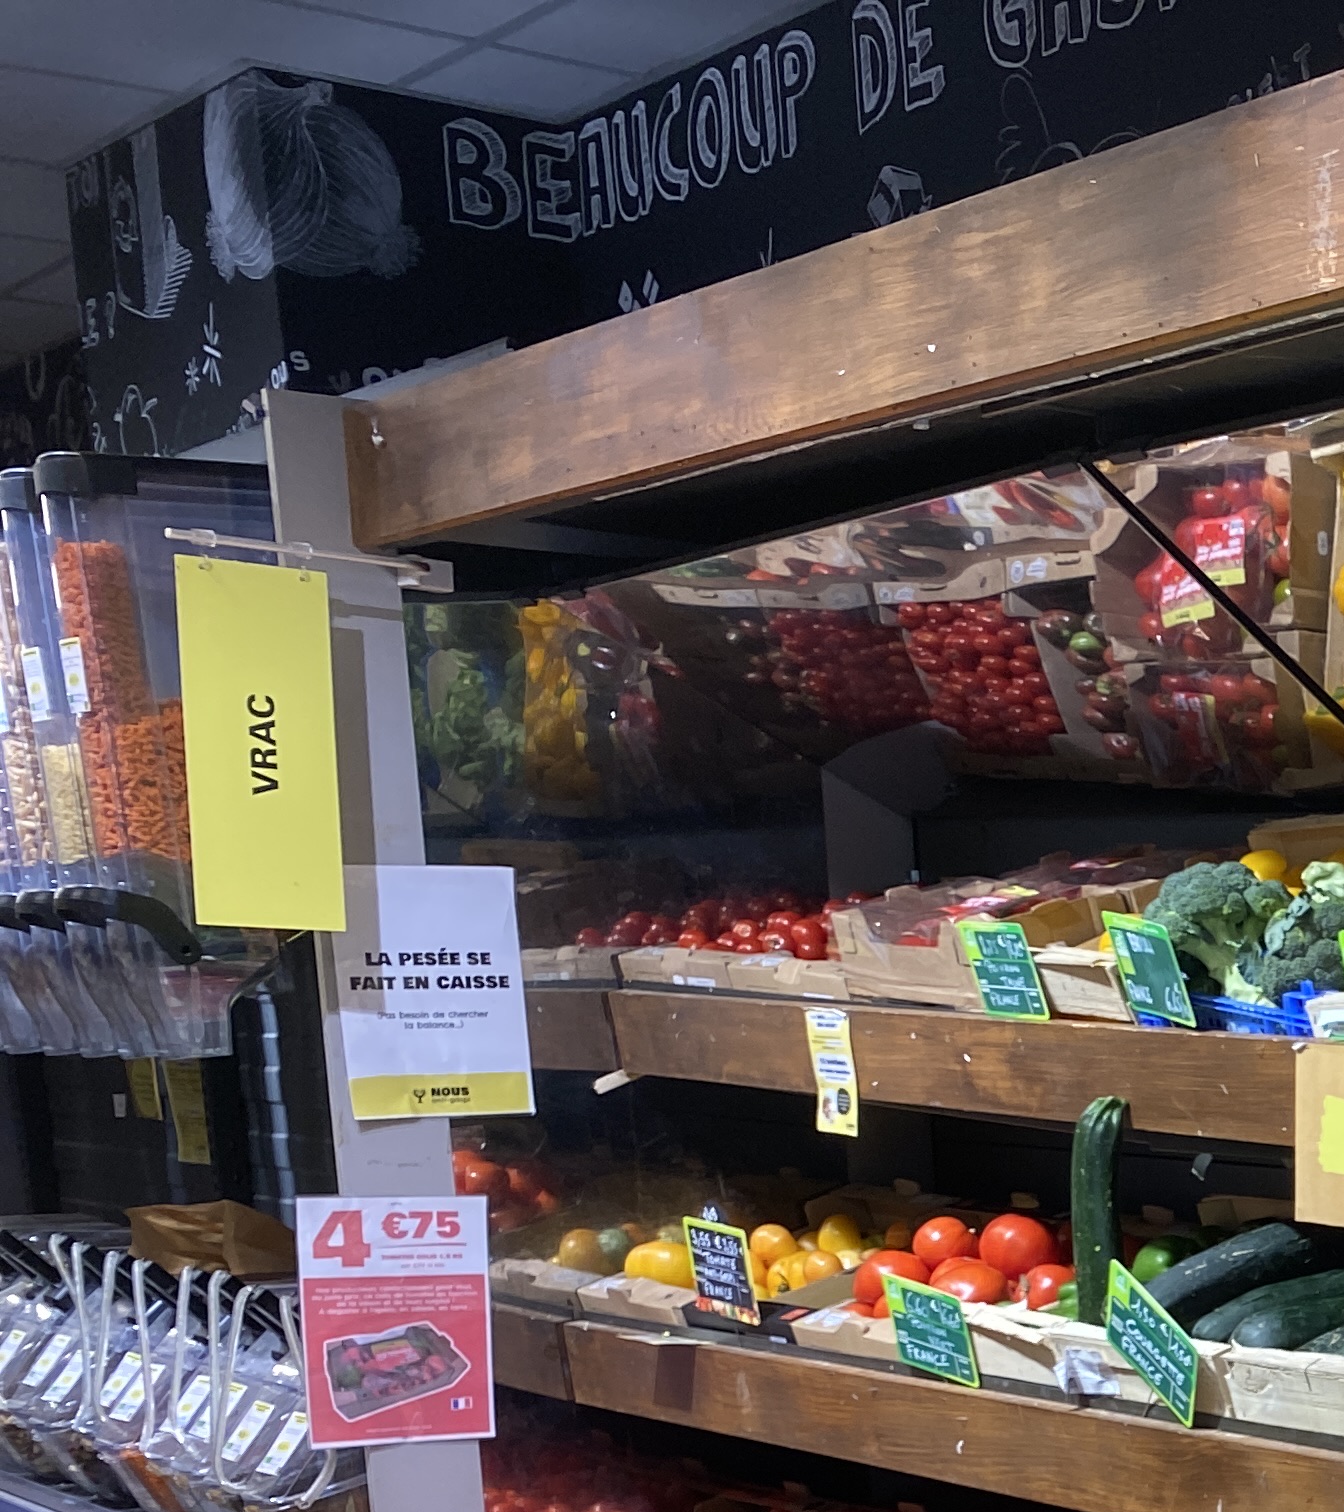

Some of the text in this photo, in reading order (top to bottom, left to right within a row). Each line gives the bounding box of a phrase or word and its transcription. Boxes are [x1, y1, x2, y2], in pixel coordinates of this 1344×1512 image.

[442, 0, 946, 244] BEAUCOUP DE
[252, 693, 277, 795] VRAC
[365, 947, 492, 967] LA PESÉE SE
[350, 973, 510, 991] FAIT EN CAISSE
[431, 1087, 470, 1097] NOUS
[312, 1210, 460, 1267] 4 €75
